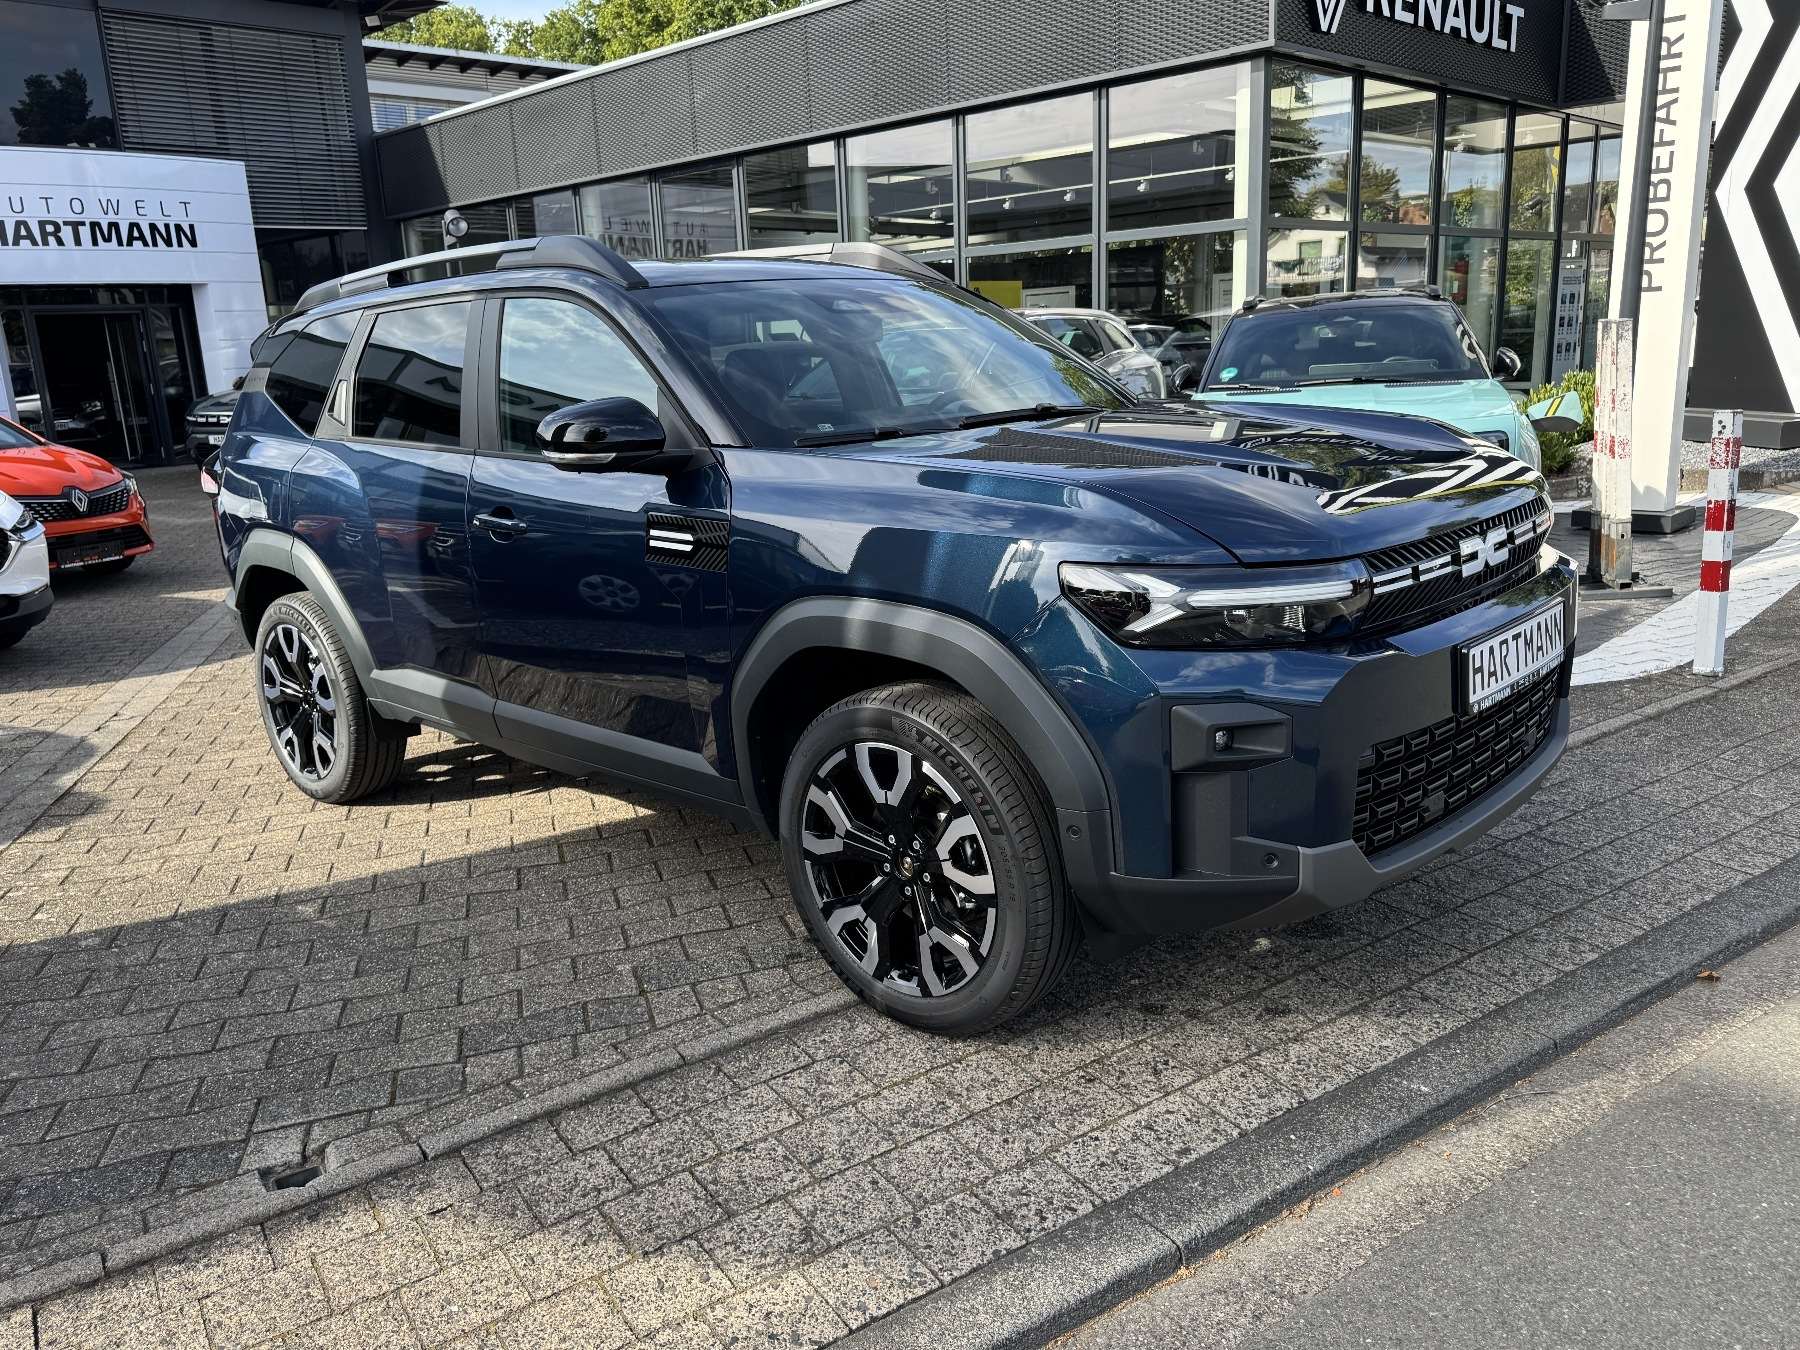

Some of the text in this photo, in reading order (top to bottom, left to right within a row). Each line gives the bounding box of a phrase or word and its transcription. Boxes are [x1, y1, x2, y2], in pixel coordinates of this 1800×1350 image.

[1366, 0, 1525, 53] ENAULT
[1472, 608, 1562, 695] HARTMANN
[920, 735, 1000, 831] MICHELIN
